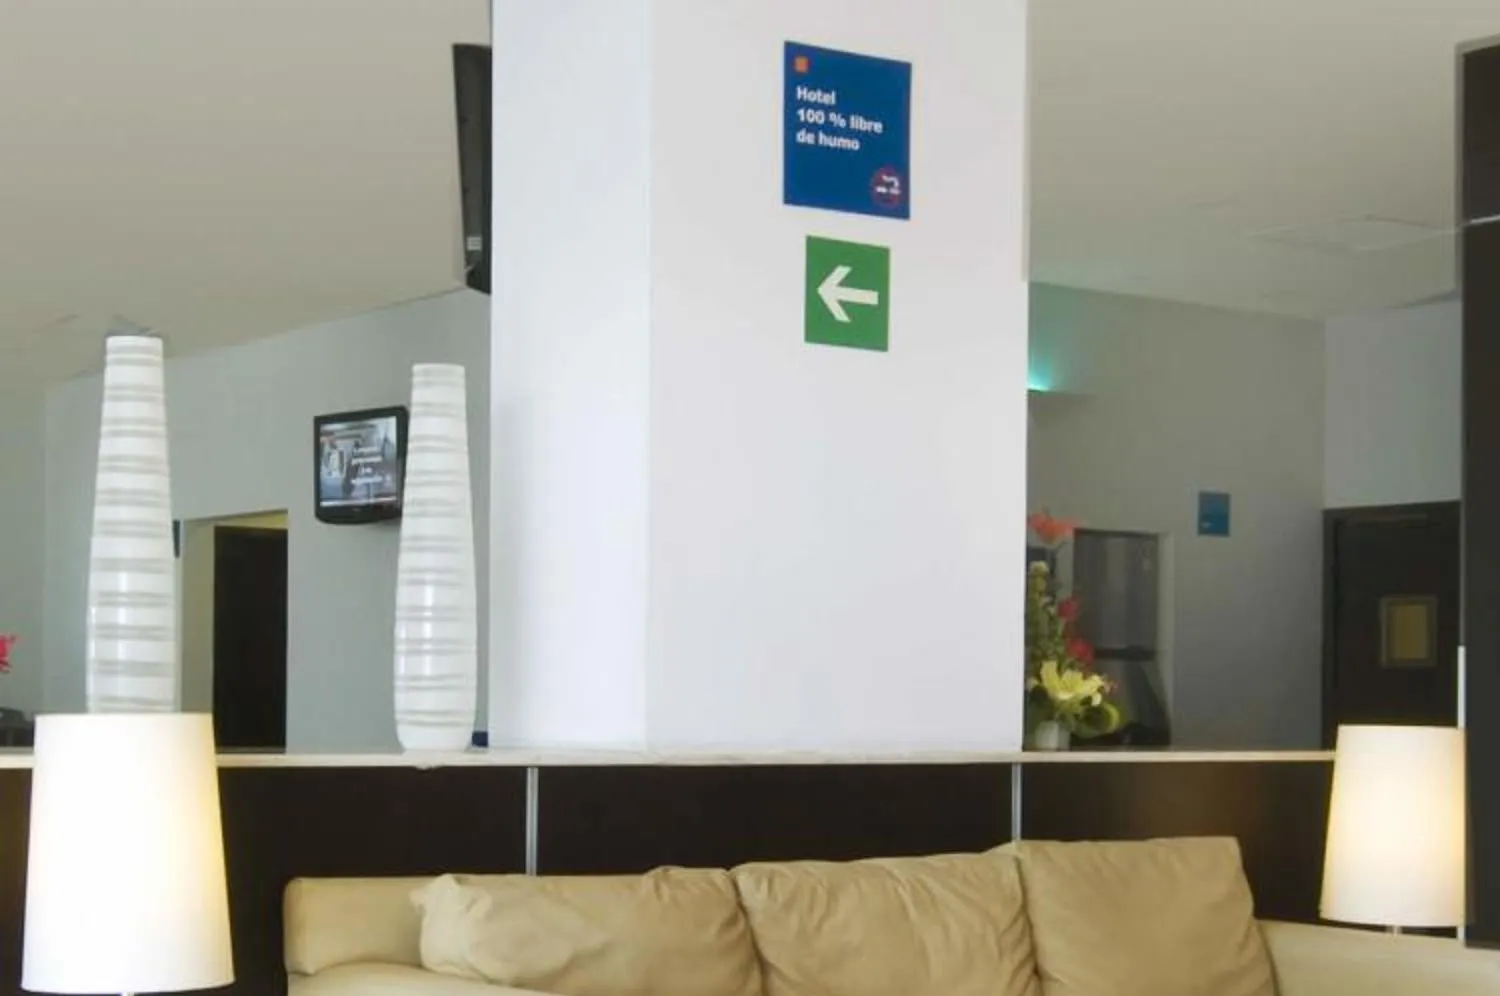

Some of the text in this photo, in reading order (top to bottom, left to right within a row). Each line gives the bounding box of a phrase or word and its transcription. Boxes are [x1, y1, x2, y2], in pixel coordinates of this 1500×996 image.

[796, 86, 836, 105] Hotel
[797, 108, 883, 134] 100 % libre
[796, 129, 860, 151] de humo
